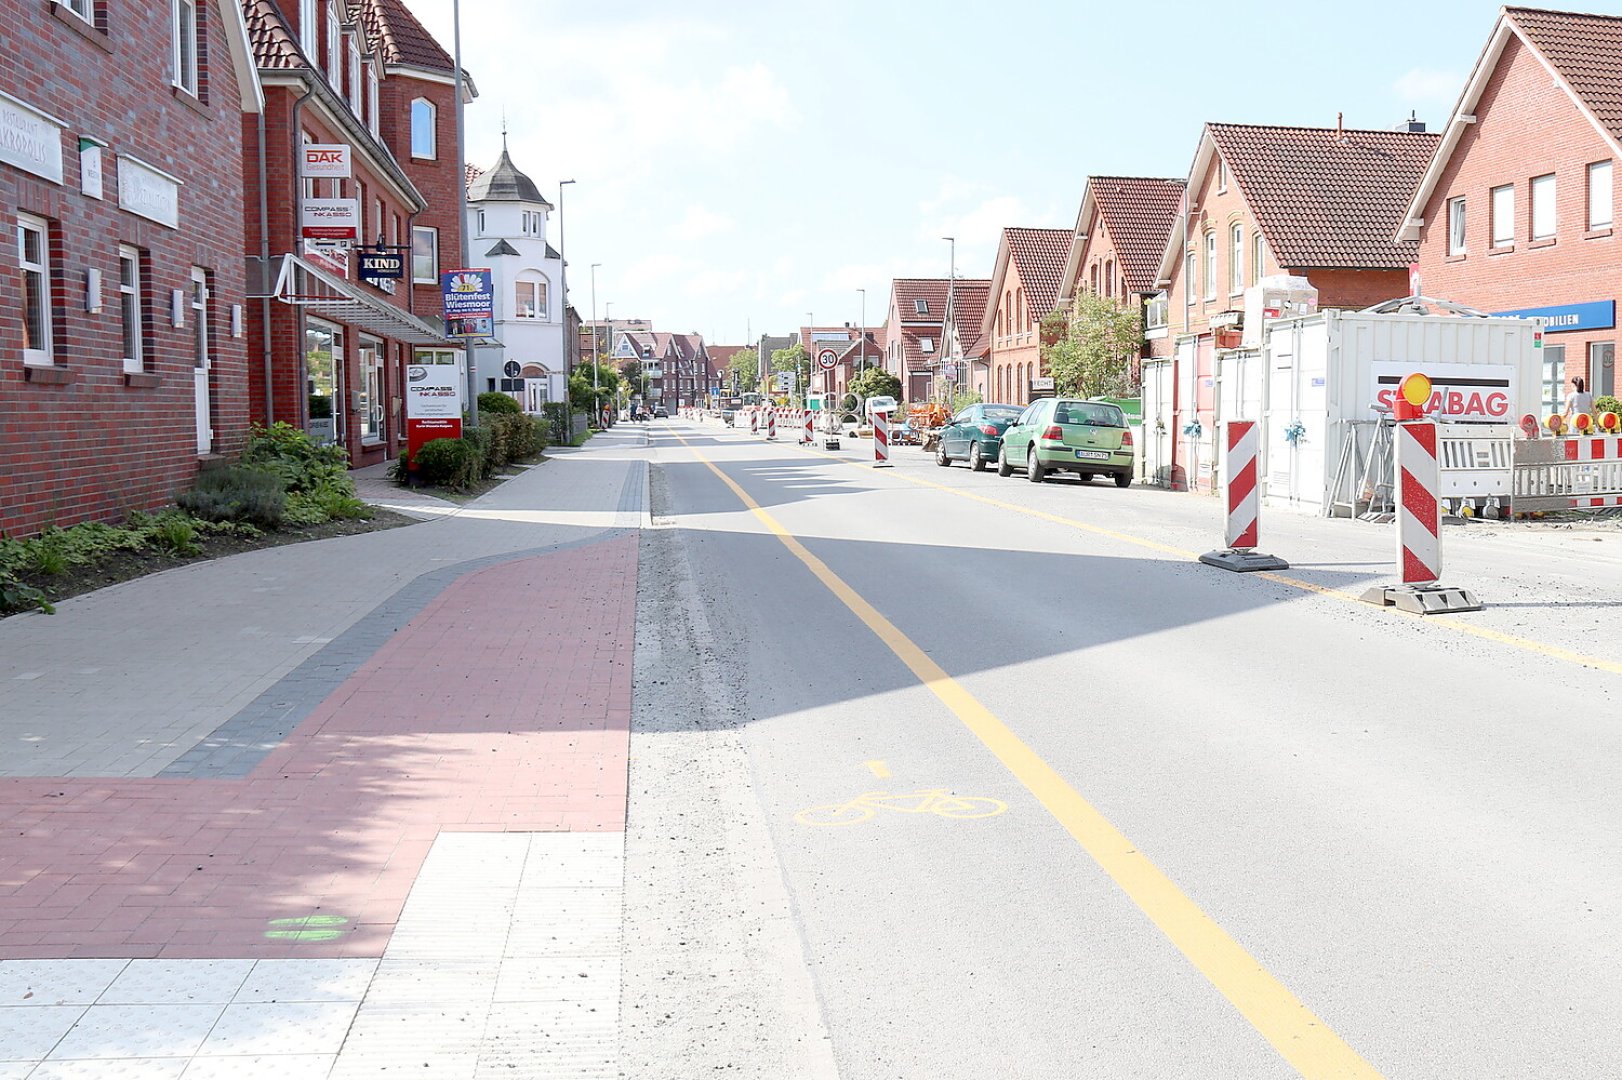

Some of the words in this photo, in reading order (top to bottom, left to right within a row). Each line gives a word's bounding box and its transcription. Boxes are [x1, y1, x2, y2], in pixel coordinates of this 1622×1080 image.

[306, 150, 343, 163] DAK
[363, 258, 400, 269] KIND
[445, 293, 491, 302] Blütenfest
[445, 301, 491, 309] Wiesmoor
[822, 354, 835, 364] 30
[1377, 388, 1509, 416] SABAG
